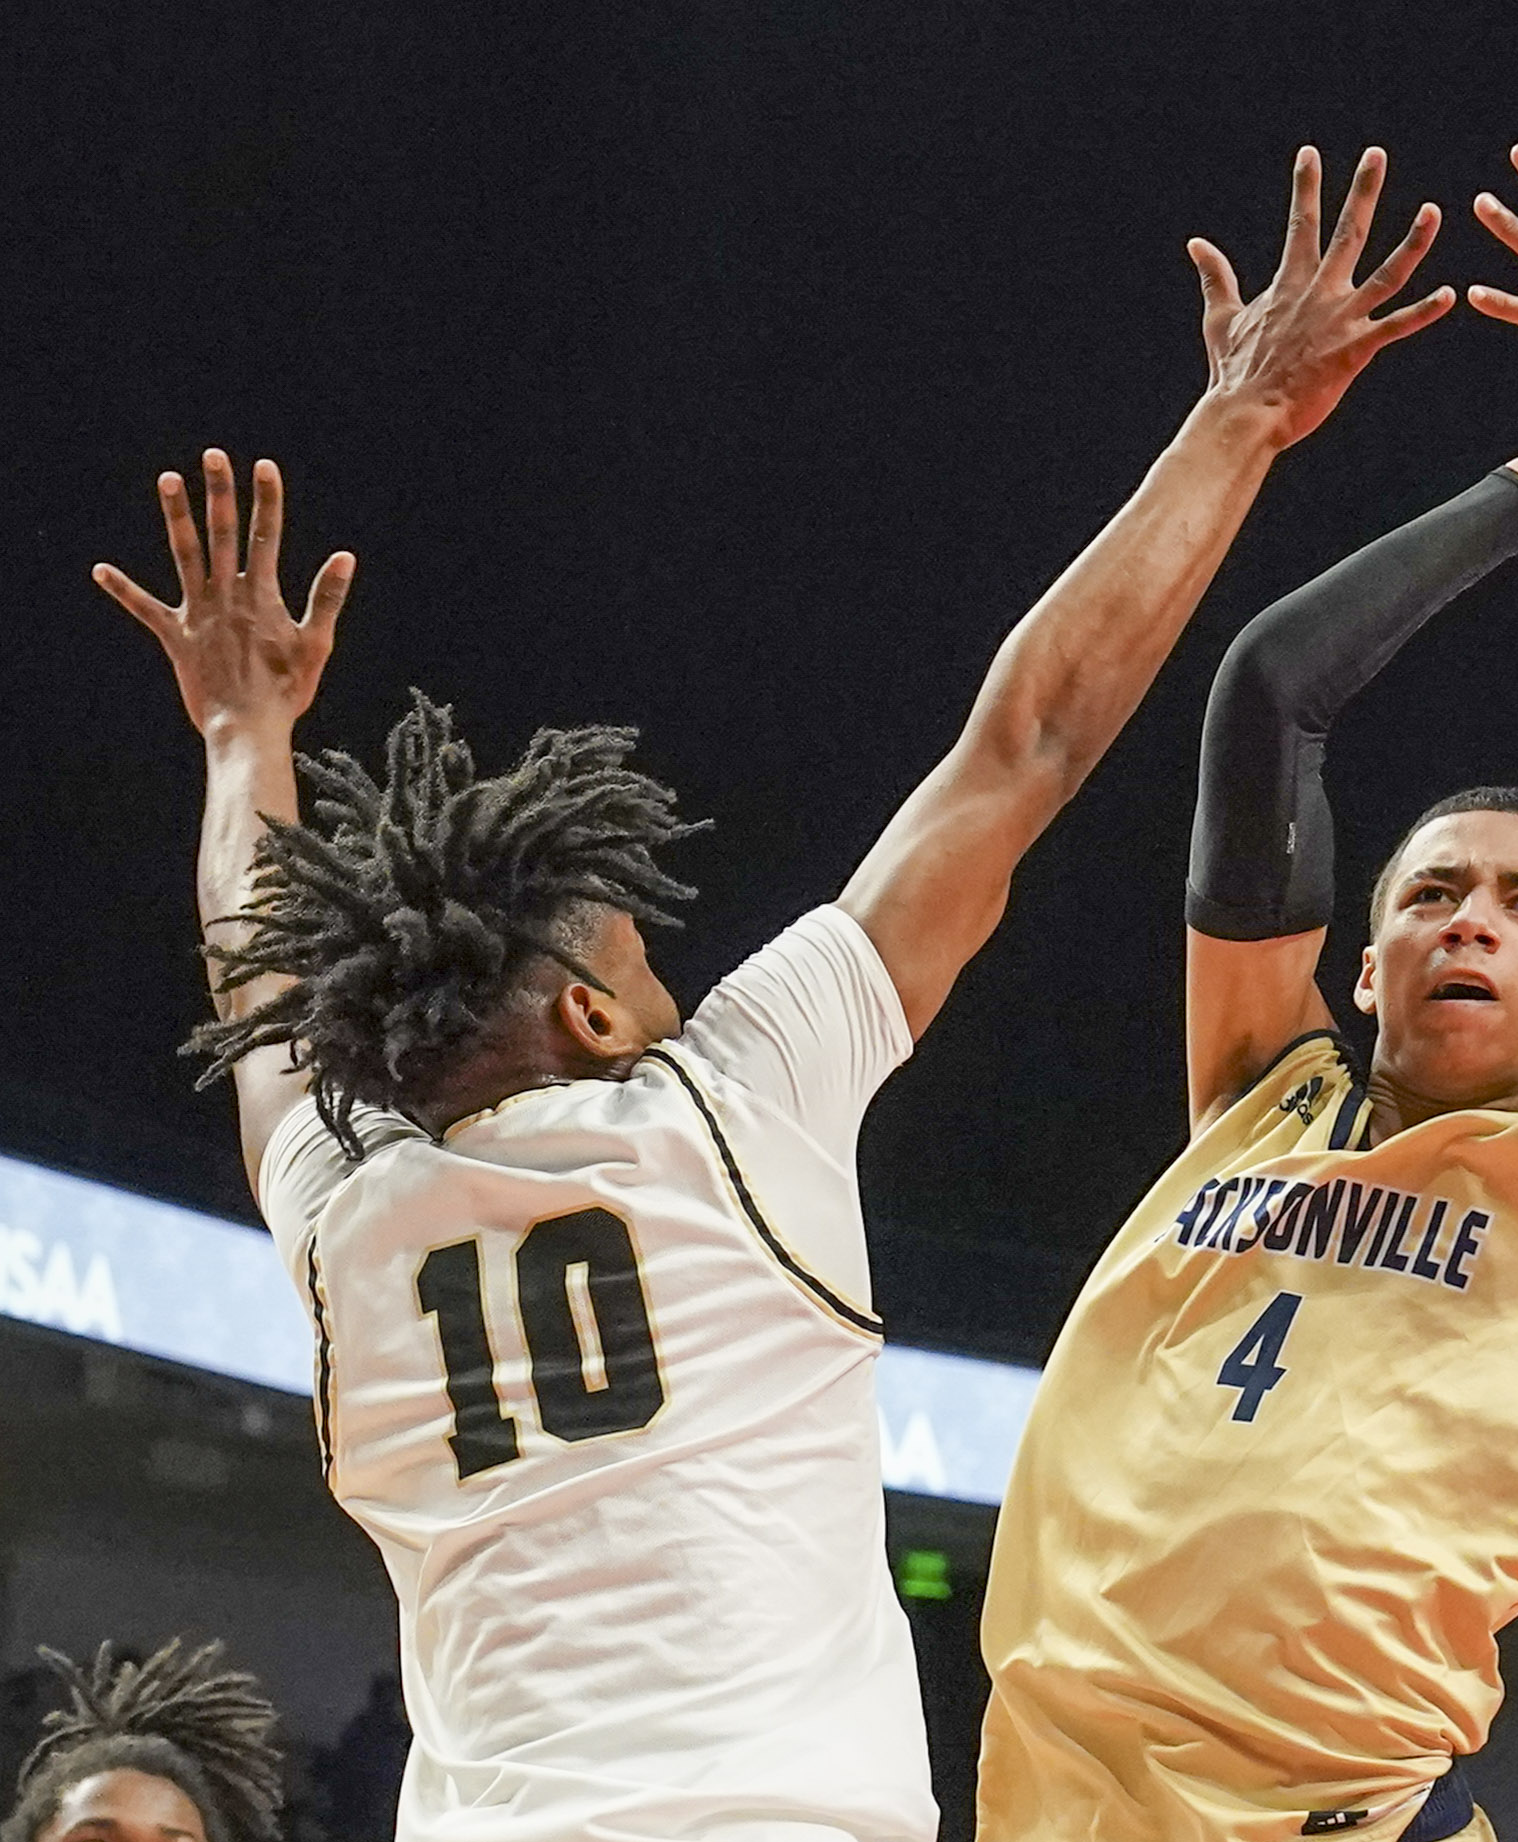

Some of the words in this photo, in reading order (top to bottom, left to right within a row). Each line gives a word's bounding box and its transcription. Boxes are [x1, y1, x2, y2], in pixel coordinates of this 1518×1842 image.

[1155, 1177, 1491, 1290] ACKSONVILLE
[414, 1203, 668, 1483] 10
[1216, 1291, 1304, 1423] 4
